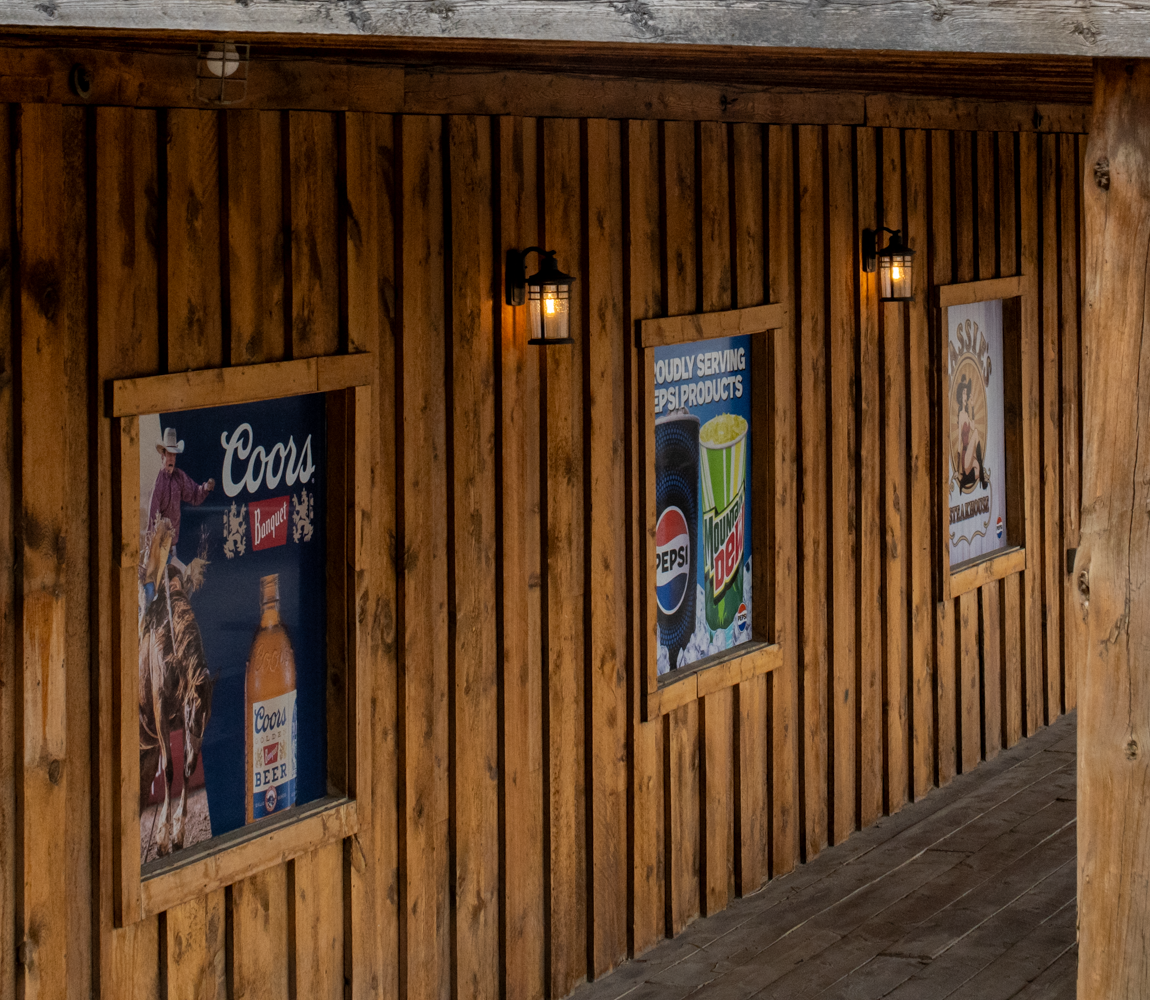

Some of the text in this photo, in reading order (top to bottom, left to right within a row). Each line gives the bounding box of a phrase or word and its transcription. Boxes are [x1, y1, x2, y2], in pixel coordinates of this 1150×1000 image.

[696, 347, 746, 377] SERVING
[680, 374, 744, 408] PRODUCTS
[220, 423, 316, 497] Coors
[254, 501, 287, 545] Banquet
[254, 705, 287, 734] Coors
[255, 763, 288, 788] BEER
